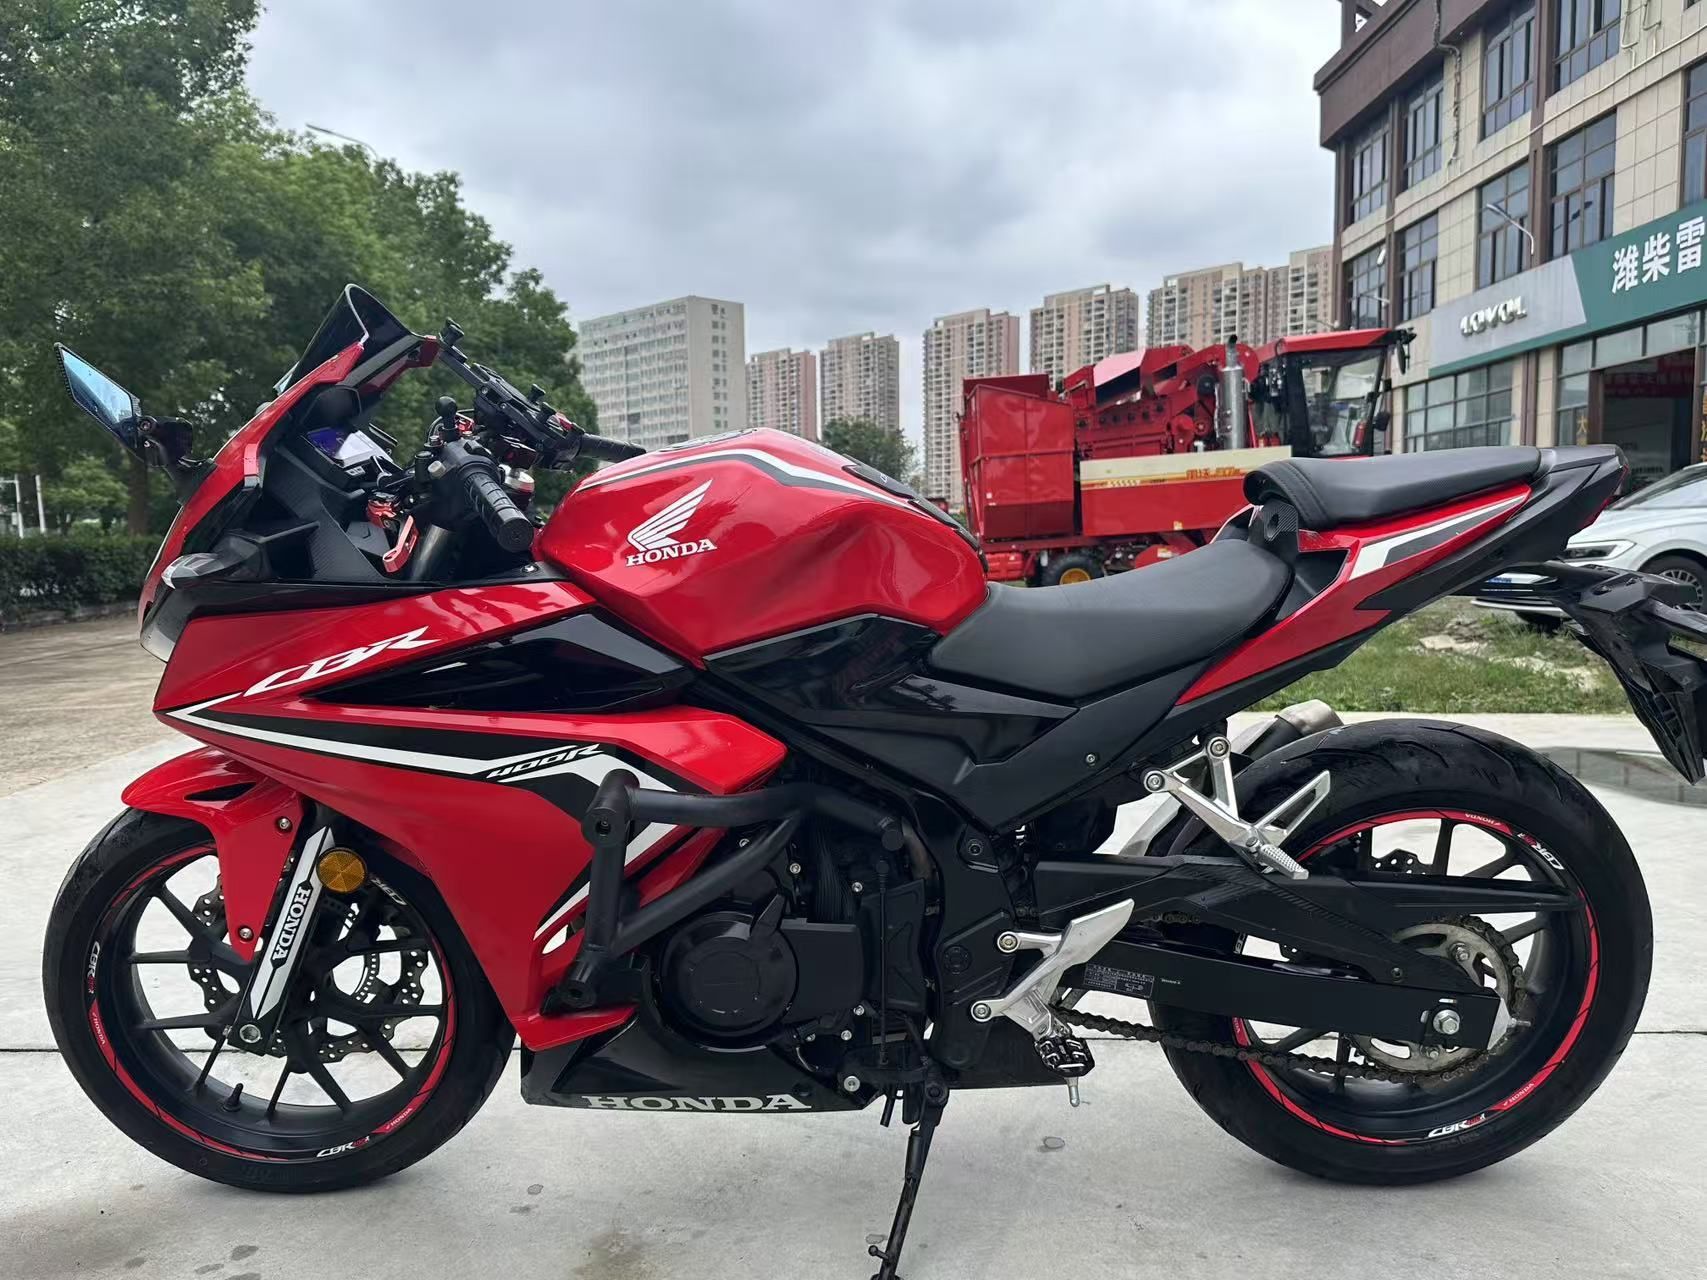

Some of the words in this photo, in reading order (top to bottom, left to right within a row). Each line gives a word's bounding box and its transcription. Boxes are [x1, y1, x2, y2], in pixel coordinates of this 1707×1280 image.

[1612, 216, 1706, 294] 潍柴雷
[626, 538, 718, 567] HONDA
[243, 625, 442, 697] CBR
[1465, 813, 1494, 824] HONDA
[272, 886, 312, 960] HONDA
[94, 1017, 106, 1045] HONDA
[582, 1093, 812, 1111] HONDA
[1509, 1083, 1535, 1103] HONDA
[390, 1108, 413, 1127] HONDA
